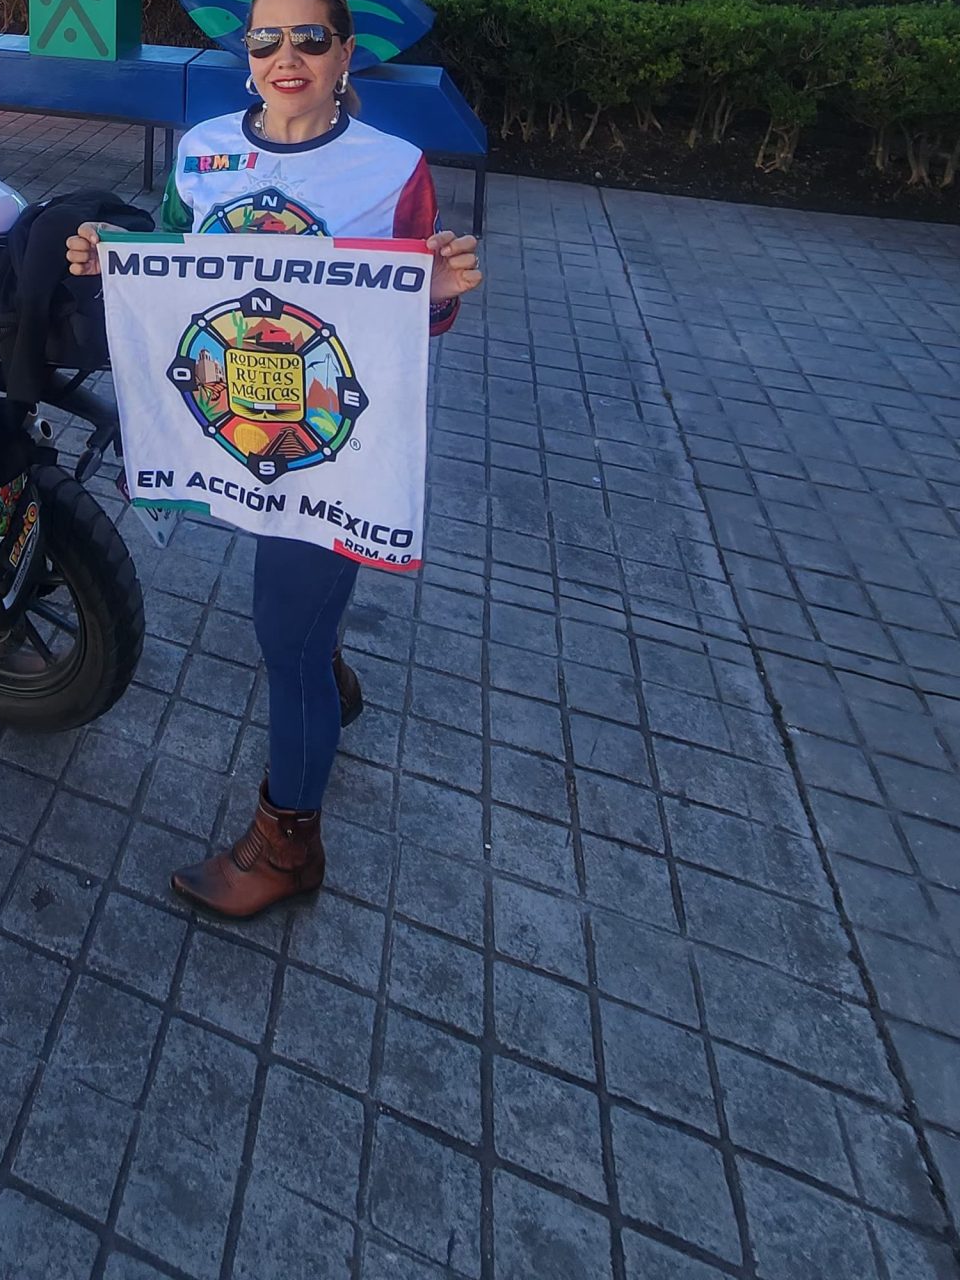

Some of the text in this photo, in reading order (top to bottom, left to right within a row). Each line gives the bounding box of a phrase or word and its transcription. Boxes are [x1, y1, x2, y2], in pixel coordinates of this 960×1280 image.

[185, 154, 230, 171] RRM
[260, 195, 278, 208] N
[108, 251, 426, 293] MOTOTURISMO
[251, 296, 272, 312] N
[343, 389, 361, 407] E
[258, 461, 276, 476] S
[137, 470, 414, 548] EN ACCIÓN MÉXICO
[343, 538, 413, 565] RRM 4.0
